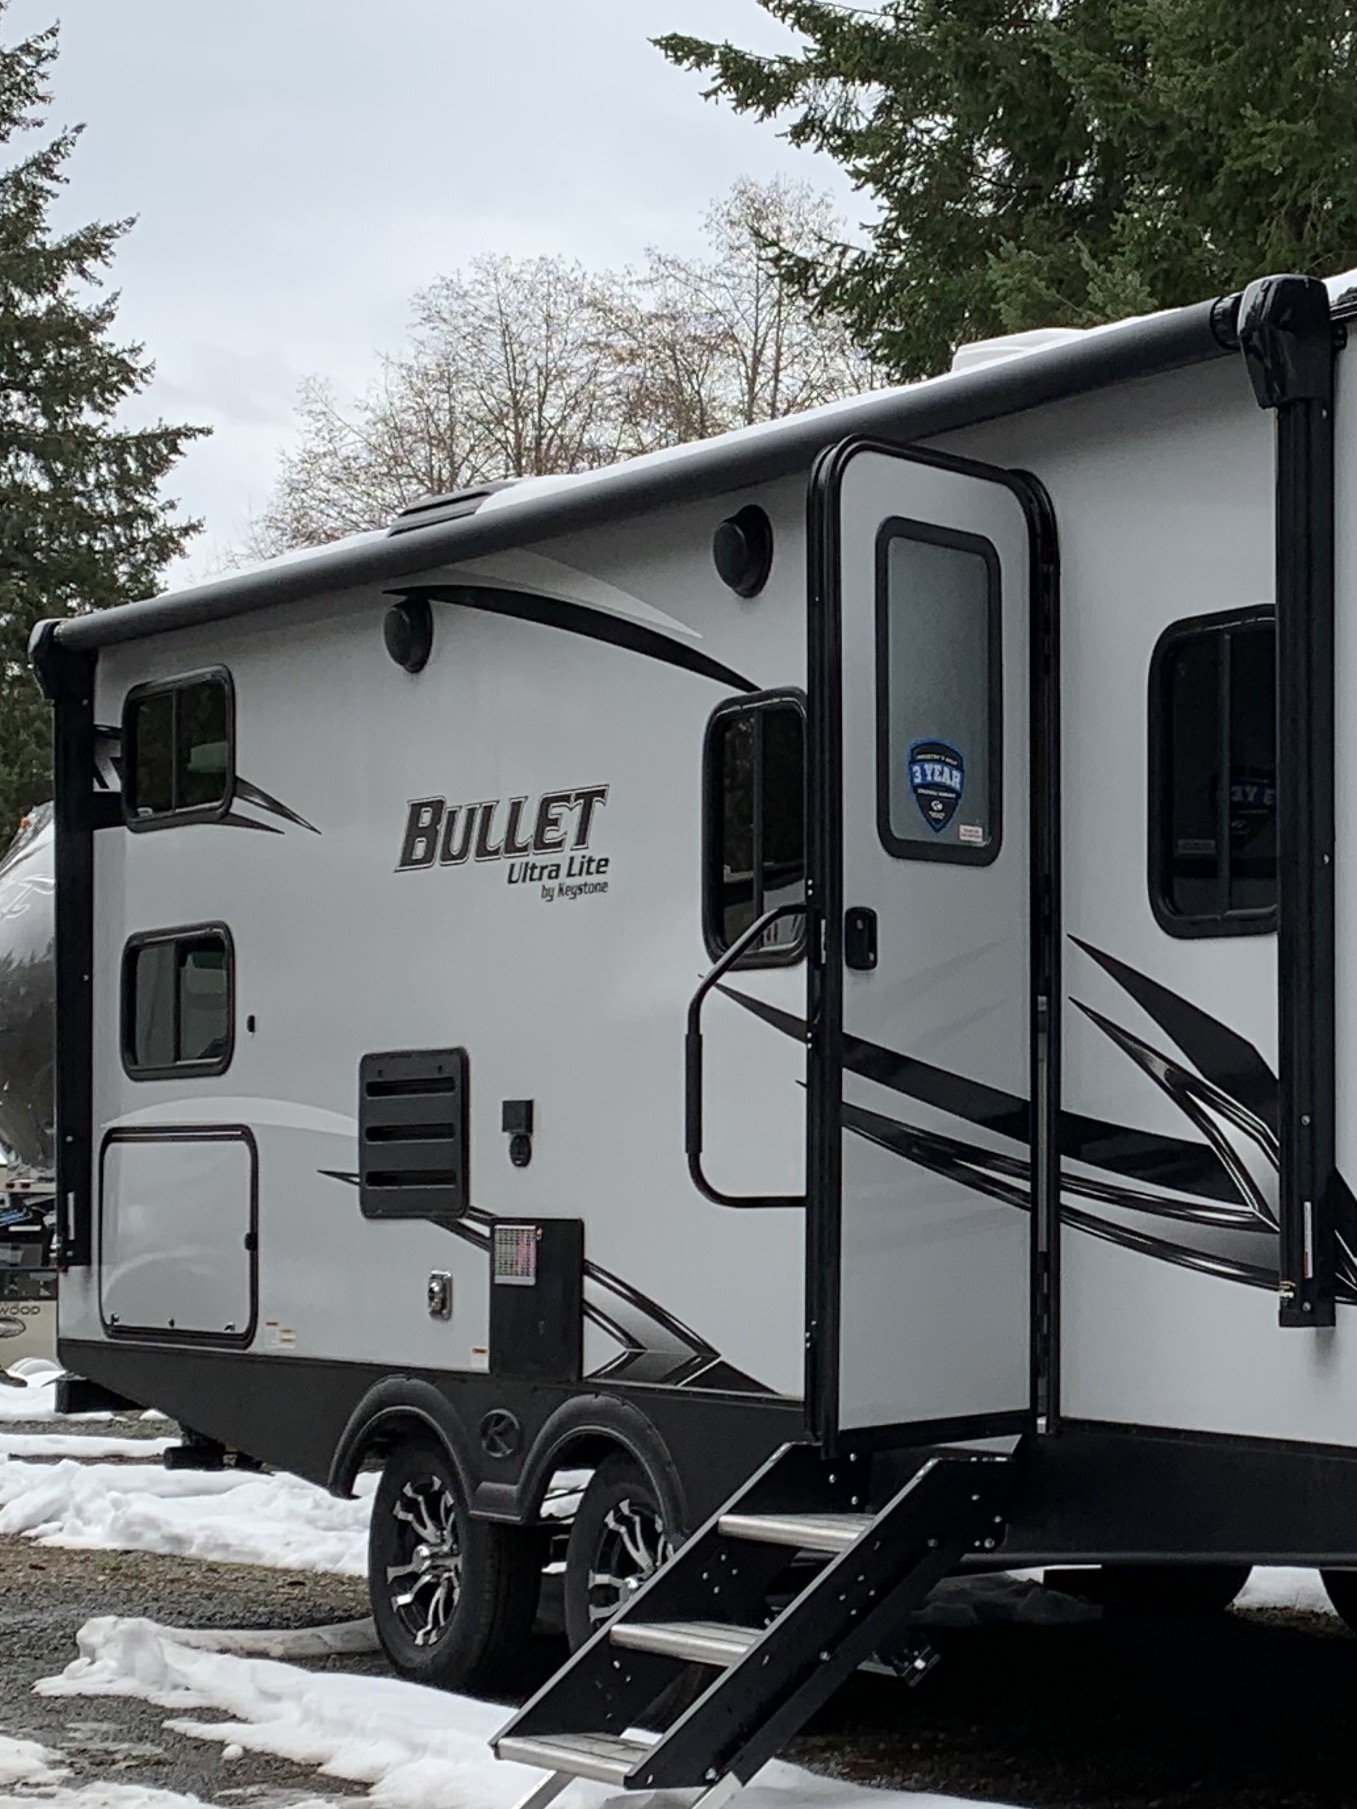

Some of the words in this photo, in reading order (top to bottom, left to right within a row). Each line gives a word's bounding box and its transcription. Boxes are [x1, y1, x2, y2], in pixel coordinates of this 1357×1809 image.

[912, 765, 922, 783] 3
[924, 763, 961, 790] YEAR
[393, 783, 611, 873] BULLET
[507, 859, 560, 885] Ultra
[566, 854, 610, 879] Lite
[541, 884, 556, 902] by
[557, 880, 609, 900] Keystone
